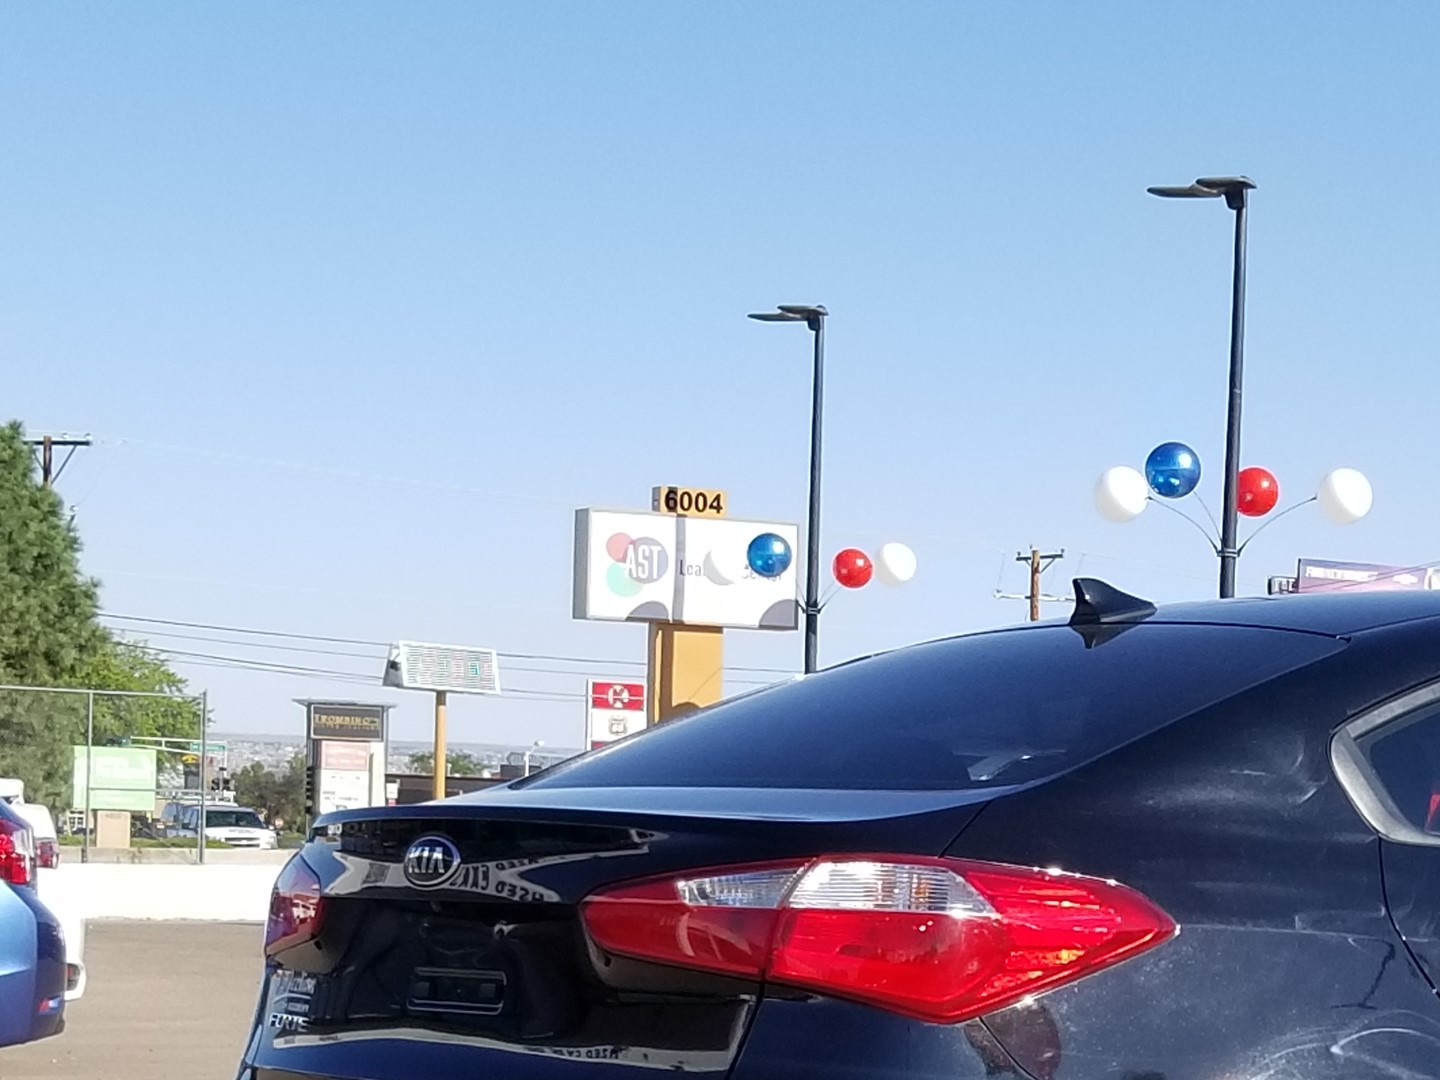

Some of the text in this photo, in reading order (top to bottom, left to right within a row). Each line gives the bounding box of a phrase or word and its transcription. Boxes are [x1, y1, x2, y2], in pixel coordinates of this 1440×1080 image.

[664, 490, 723, 514] 6004
[624, 544, 662, 580] AST
[408, 846, 445, 874] KIA
[269, 1013, 311, 1032] FORTE
